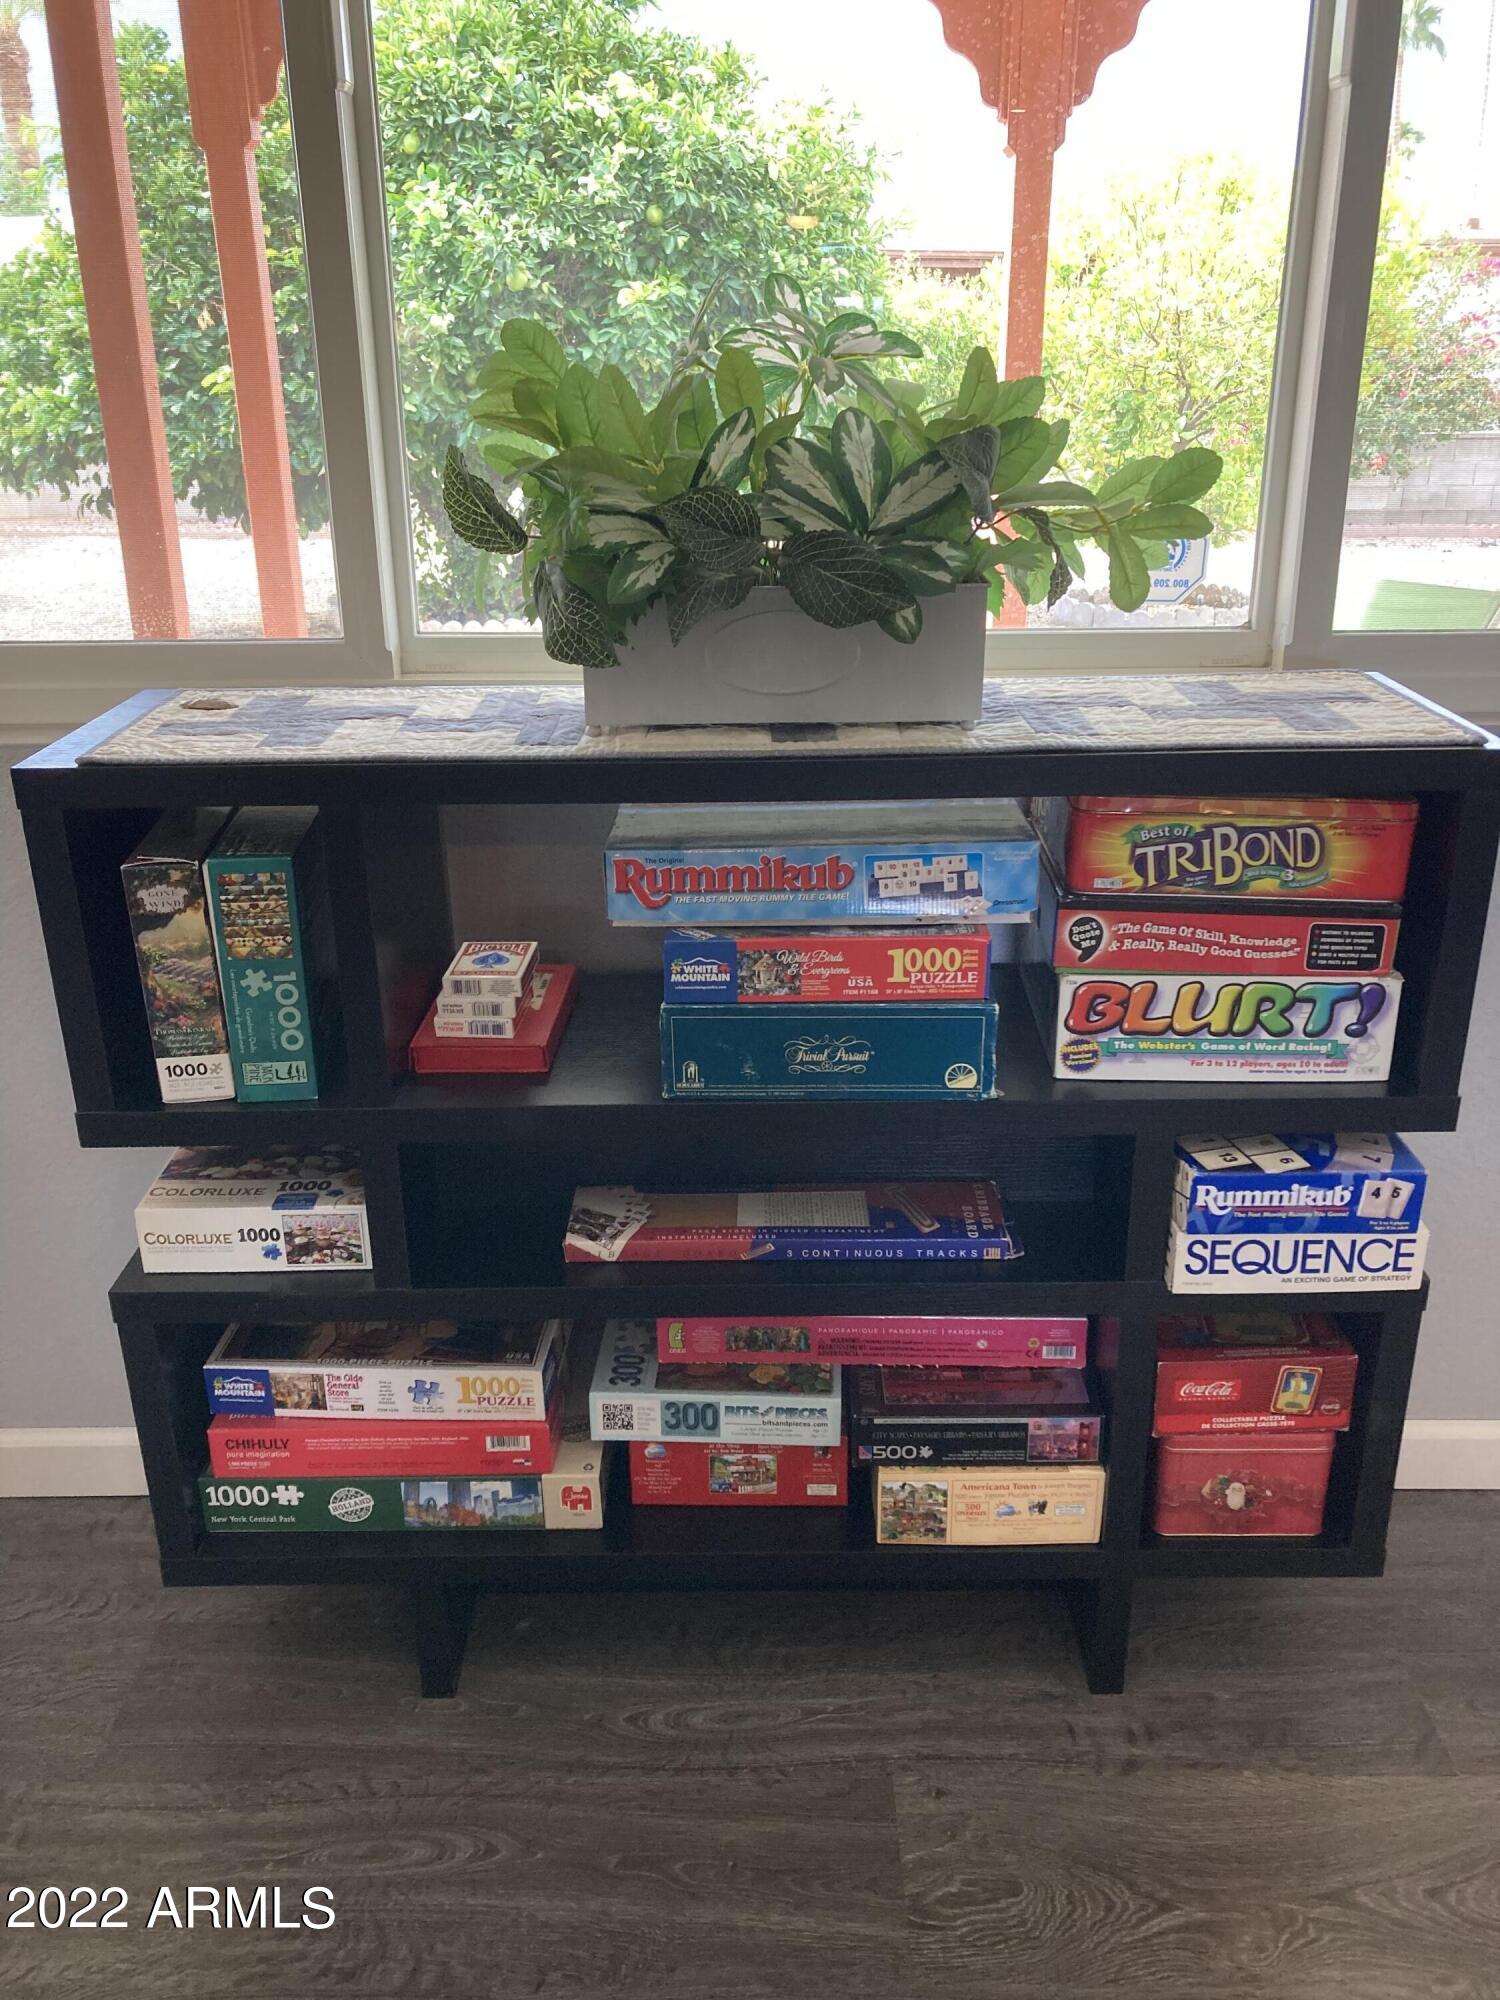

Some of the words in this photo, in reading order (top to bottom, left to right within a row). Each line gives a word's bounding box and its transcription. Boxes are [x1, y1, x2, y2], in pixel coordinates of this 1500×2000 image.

[1140, 826, 1170, 840] Best
[1174, 826, 1190, 836] of
[658, 857, 684, 865] Original
[612, 855, 855, 910] Rummikub
[148, 900, 182, 909] WIND
[674, 896, 693, 904] THE
[694, 895, 718, 904] FAST
[718, 894, 758, 904] MOVING
[758, 894, 795, 902] RUMMY
[798, 893, 816, 901] TILE
[818, 892, 850, 901] GAME!
[1072, 922, 1098, 934] Don't
[1072, 930, 1100, 942] Quote
[1142, 922, 1176, 935] Game
[1178, 926, 1194, 936] Of
[1196, 928, 1227, 944] Skill,
[1229, 934, 1298, 948] Knowledge
[464, 944, 528, 954] BICYCLE
[1080, 938, 1096, 948] Me
[1108, 942, 1120, 951] &
[1122, 939, 1166, 952] Really,
[1168, 940, 1208, 956] Really
[1210, 946, 1242, 957] Good
[776, 950, 810, 964] Wild
[811, 950, 844, 963] Birds
[682, 964, 718, 973] WHITE
[787, 964, 800, 976] &
[800, 963, 851, 980] Evergreens
[886, 947, 962, 983] 1000
[670, 973, 730, 982] MOUNTAIN
[848, 978, 874, 987] USA
[910, 972, 978, 984] PUZZLE
[272, 971, 304, 1051] 1000
[1064, 980, 1387, 1038] BLURT!
[246, 1008, 254, 1036] Grandma's
[248, 1036, 257, 1054] Quilts
[1061, 1042, 1098, 1052] INCLUDES
[1114, 1041, 1134, 1049] The
[1138, 1041, 1196, 1050] Webster's
[1201, 1042, 1236, 1050] Game
[1238, 1042, 1252, 1050] of
[1254, 1042, 1286, 1050] Word
[1288, 1042, 1332, 1053] Racing!
[785, 1045, 829, 1064] Trivial
[830, 1046, 870, 1062] Pursuit
[164, 1062, 208, 1078] 1000
[1240, 1060, 1274, 1070] players,
[248, 1064, 262, 1084] PINE
[260, 1064, 274, 1084] JACK
[1218, 1152, 1239, 1163] 13
[150, 1186, 268, 1197] COLORLUXE
[276, 1180, 332, 1192] 1000
[1371, 1186, 1382, 1200] 4
[1391, 1186, 1402, 1200] 5
[1196, 1183, 1352, 1216] Rummikub
[973, 1184, 995, 1231] CRIBBAGE
[962, 1206, 980, 1238] BOARD
[144, 1232, 232, 1245] COLORLUXE
[238, 1228, 282, 1243] 1000
[786, 1250, 792, 1258] 3
[802, 1249, 904, 1258] CONTINUOUS
[916, 1249, 978, 1258] TRACKS
[1184, 1238, 1418, 1276] SEQUENCE
[1370, 1274, 1412, 1282] STRATEGY
[608, 1354, 646, 1386] 300
[344, 1374, 364, 1382] Olde
[326, 1382, 360, 1390] General
[456, 1376, 520, 1404] 1000
[214, 1389, 266, 1397] MOUNTAIN
[477, 1396, 536, 1406] PUZZLE
[664, 1402, 718, 1431] 300
[724, 1406, 760, 1418] BITS
[775, 1406, 828, 1418] PIECES
[225, 1438, 290, 1450] CHIHULY
[246, 1451, 290, 1459] imagination
[872, 1446, 917, 1459] 500
[960, 1482, 1010, 1491] Americana
[1013, 1482, 1037, 1490] Town
[206, 1485, 270, 1506] 1000
[332, 1498, 372, 1514] HOLLAND
[965, 1503, 981, 1511] 500
